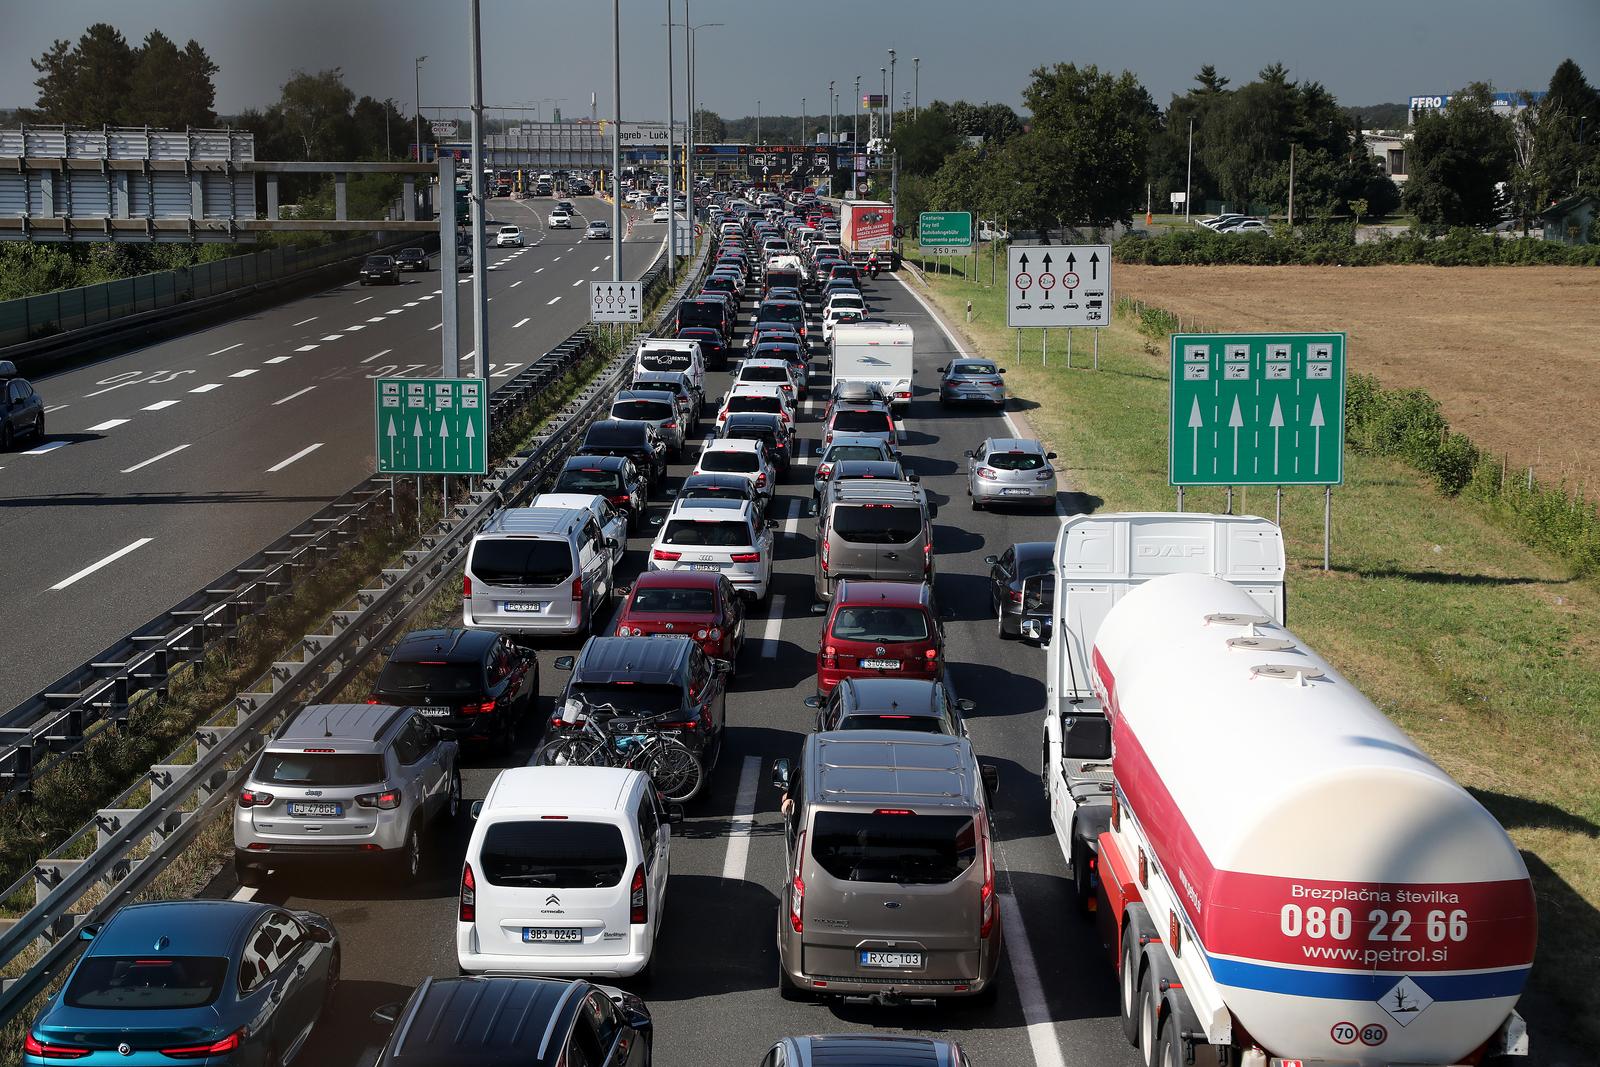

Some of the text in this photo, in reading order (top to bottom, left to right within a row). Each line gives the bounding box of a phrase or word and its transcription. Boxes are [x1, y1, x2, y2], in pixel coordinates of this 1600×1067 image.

[1411, 97, 1442, 108] FERO
[620, 131, 641, 140] agreb
[1136, 544, 1207, 558] DAF
[1291, 884, 1460, 904] Brezplačna številka
[1280, 903, 1468, 942] 080 22 66
[530, 929, 577, 940] 9B3 0245
[870, 952, 919, 965] RXC-103
[1302, 945, 1448, 964] www.petrol.si
[1336, 1028, 1353, 1039] 70
[1363, 1029, 1383, 1041] 80
